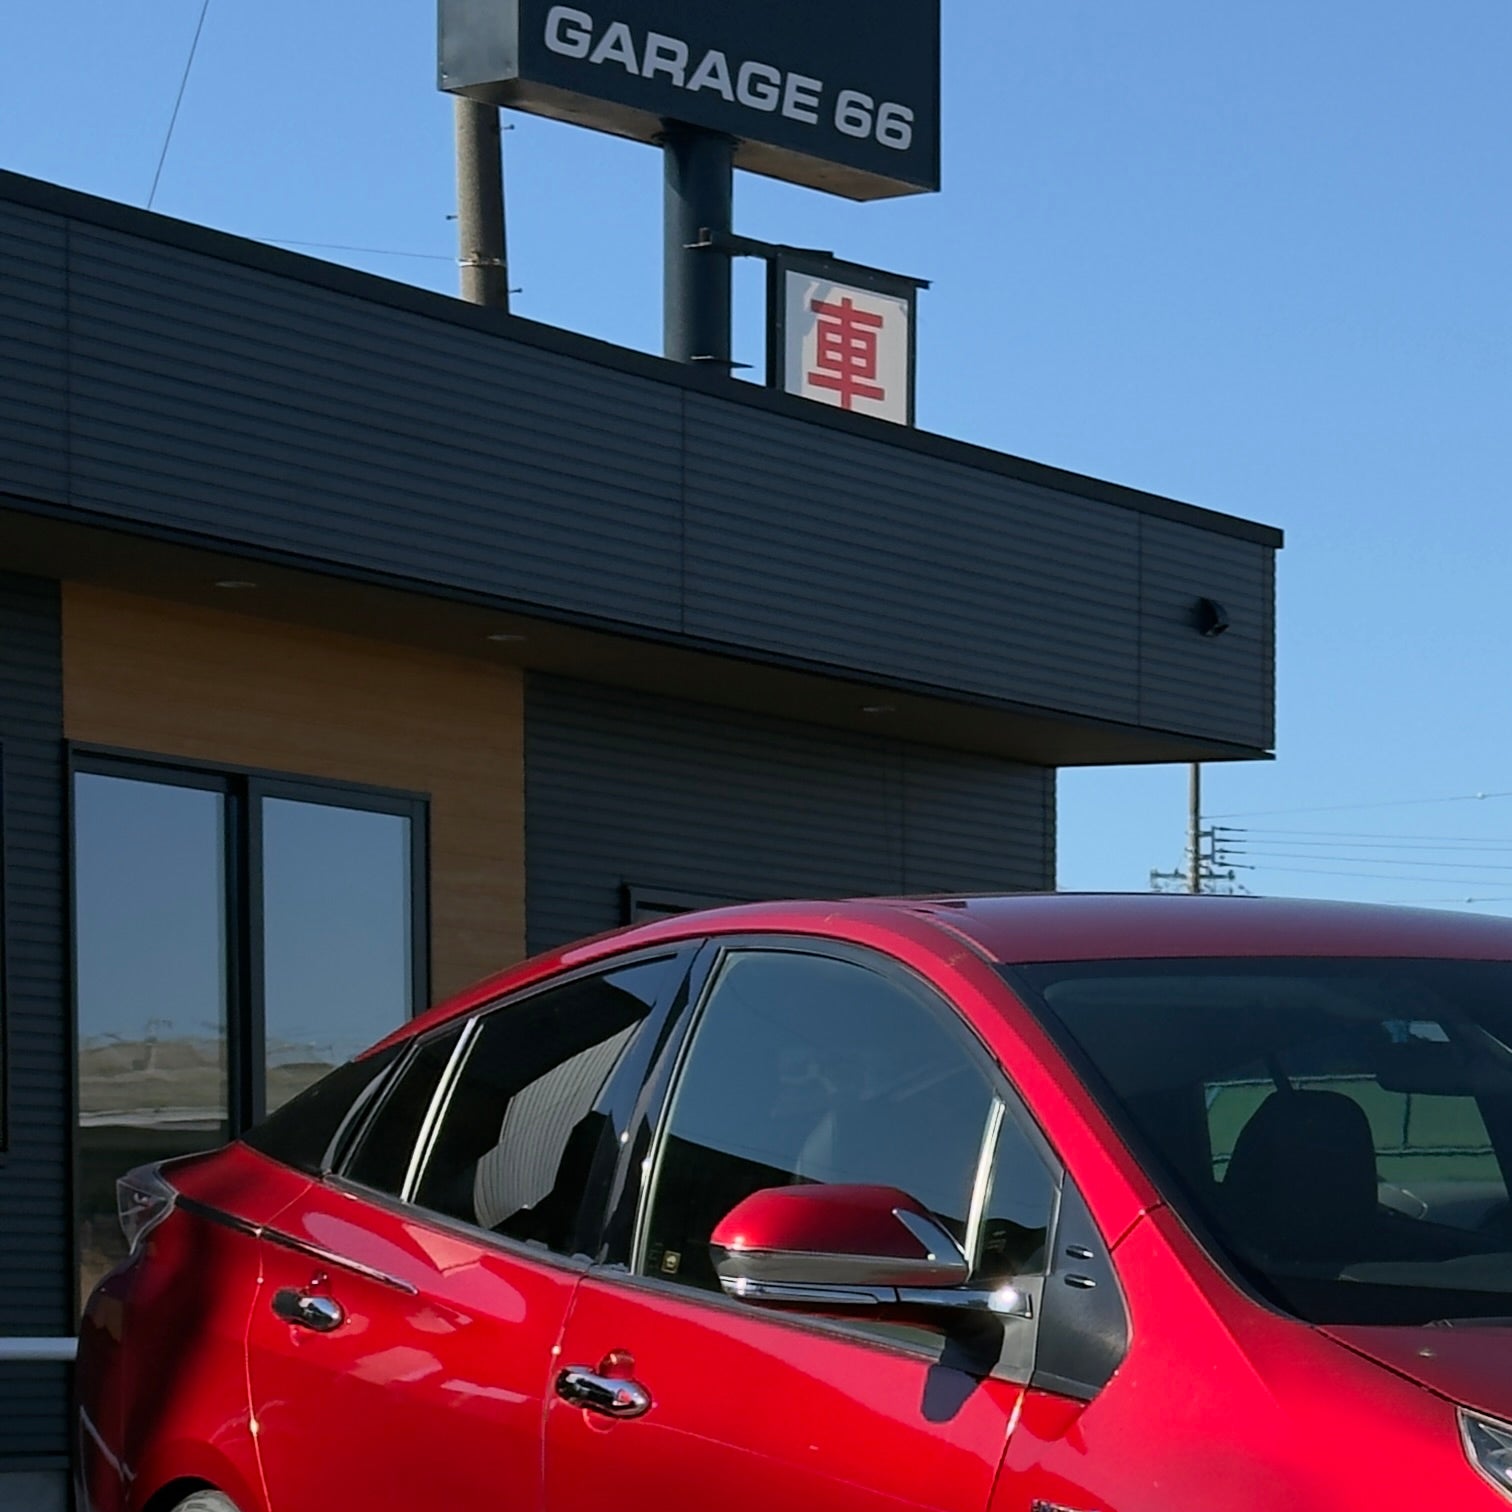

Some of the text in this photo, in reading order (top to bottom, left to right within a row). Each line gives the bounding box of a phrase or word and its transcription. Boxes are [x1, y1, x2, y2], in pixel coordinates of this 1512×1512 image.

[545, 6, 915, 151] GARAGE 66
[808, 297, 885, 410] 車
